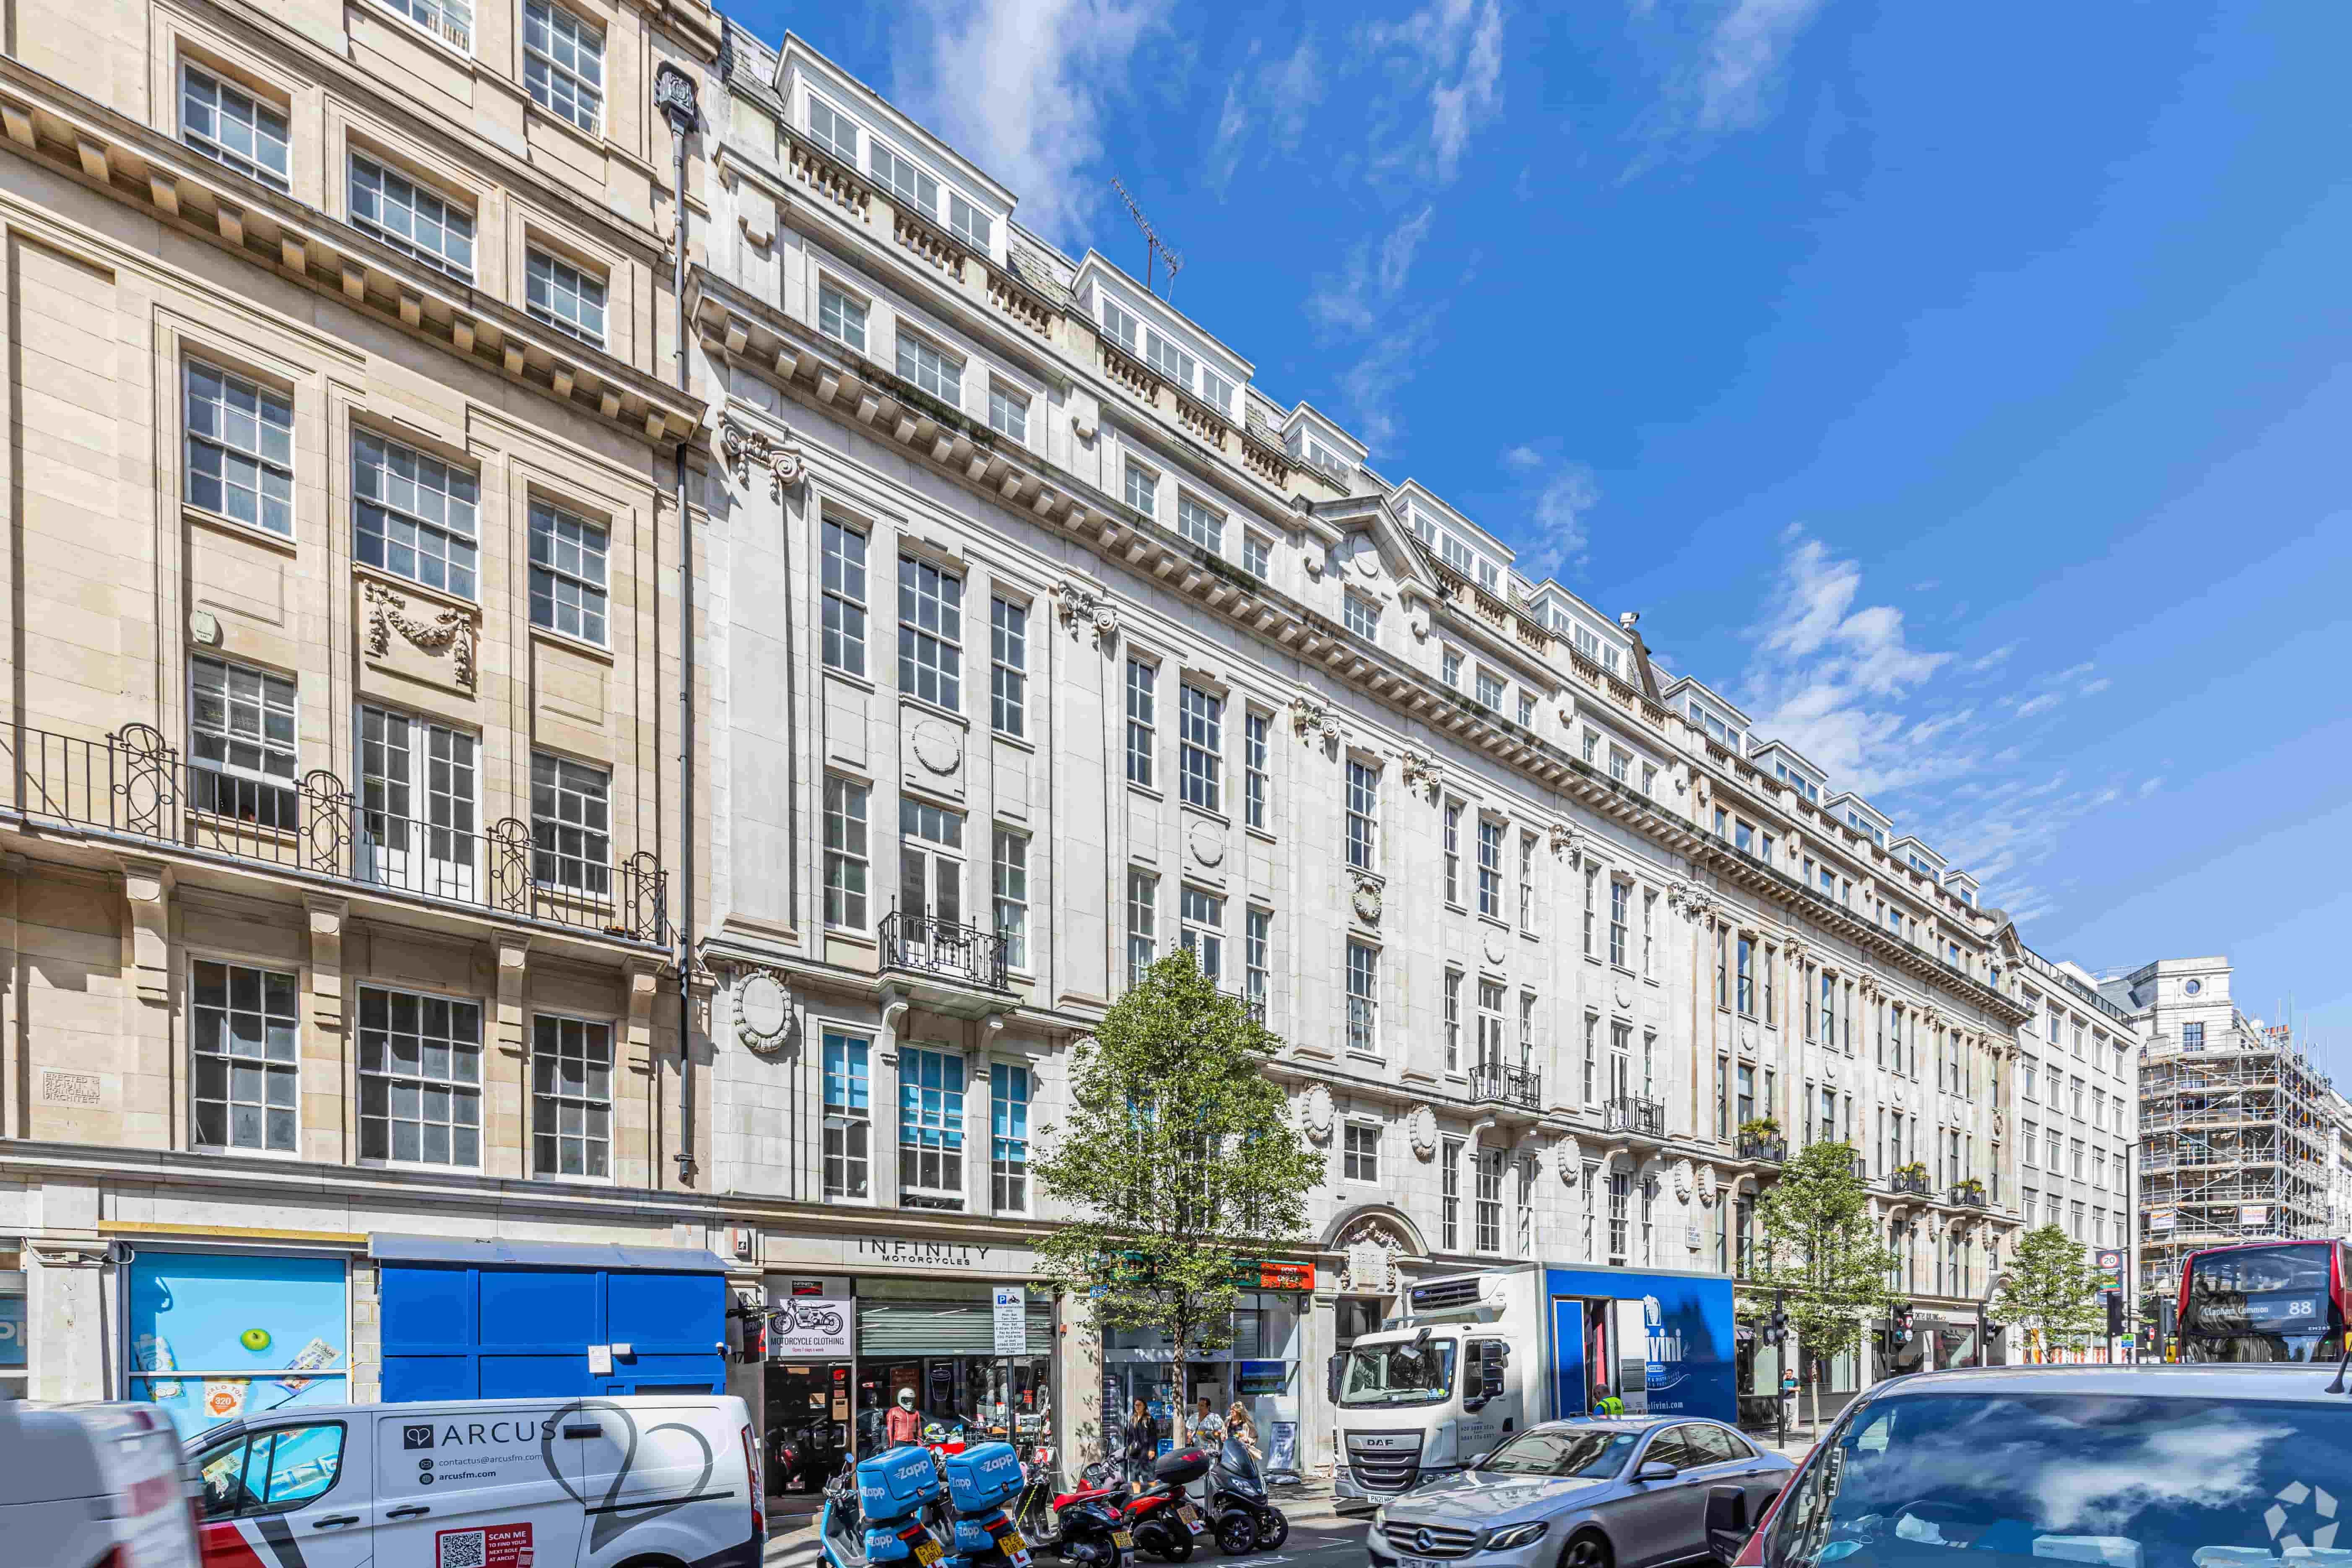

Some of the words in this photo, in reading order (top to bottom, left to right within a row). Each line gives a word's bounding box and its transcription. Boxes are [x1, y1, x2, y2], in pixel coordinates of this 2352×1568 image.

[46, 1074, 87, 1084] ERECTED
[46, 1093, 100, 1104] ARCHITECT
[859, 1238, 990, 1260] INFINITY
[882, 1254, 970, 1266] MOTORCYCLES
[2204, 1308, 2235, 1316] Clapham
[2238, 1305, 2269, 1314] Common
[2289, 1301, 2312, 1316] 88
[771, 1337, 812, 1345] MOTORCYCLE
[813, 1337, 844, 1346] CLOTHING
[214, 1396, 231, 1406] 320
[441, 1420, 556, 1446] ARCUS
[439, 1453, 543, 1467] contactus@arcusfm.com
[984, 1454, 1014, 1473] Zapp
[439, 1470, 496, 1481] arcusfm.com
[898, 1459, 929, 1480] Zapp
[489, 1532, 511, 1541] SCAN
[1013, 1552, 1026, 1564] L
